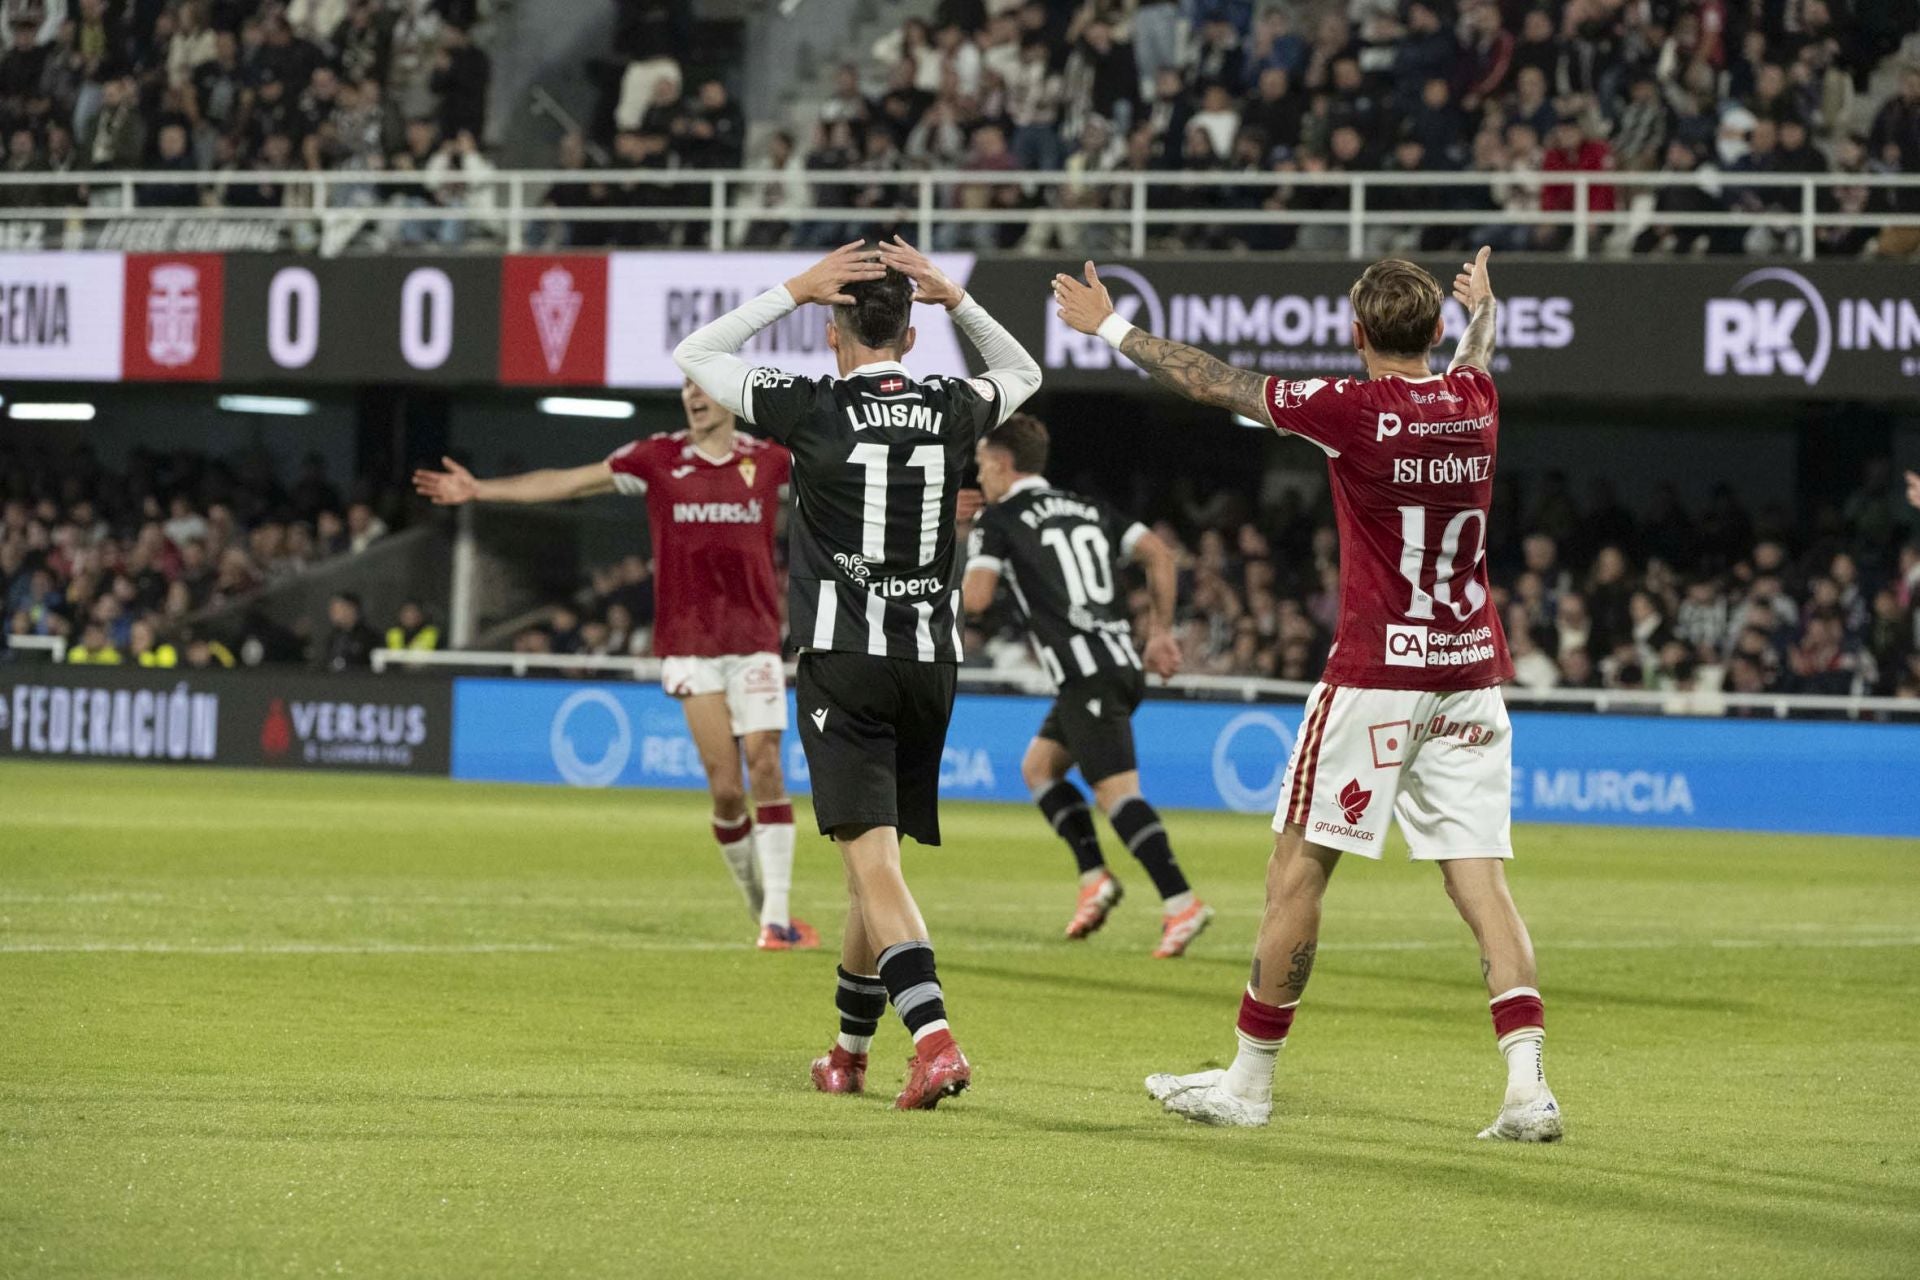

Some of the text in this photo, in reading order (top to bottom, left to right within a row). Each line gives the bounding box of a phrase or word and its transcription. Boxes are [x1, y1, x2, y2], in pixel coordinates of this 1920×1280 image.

[0, 285, 69, 346] ENA
[268, 266, 454, 369] 0 0
[1705, 298, 1806, 375] RK
[846, 402, 942, 435] LUISMI
[1393, 453, 1491, 484] ISI GÓMEZ
[846, 442, 945, 567] 11
[868, 576, 943, 597] ribera
[1041, 524, 1114, 605] 10
[1397, 505, 1486, 622] 10
[12, 681, 219, 759] FEDERACIÓN
[290, 702, 427, 745] VERSUS
[1413, 715, 1494, 746] rdpiso
[1532, 769, 1694, 815] MURCIA
[1315, 820, 1375, 842] grupolucas
